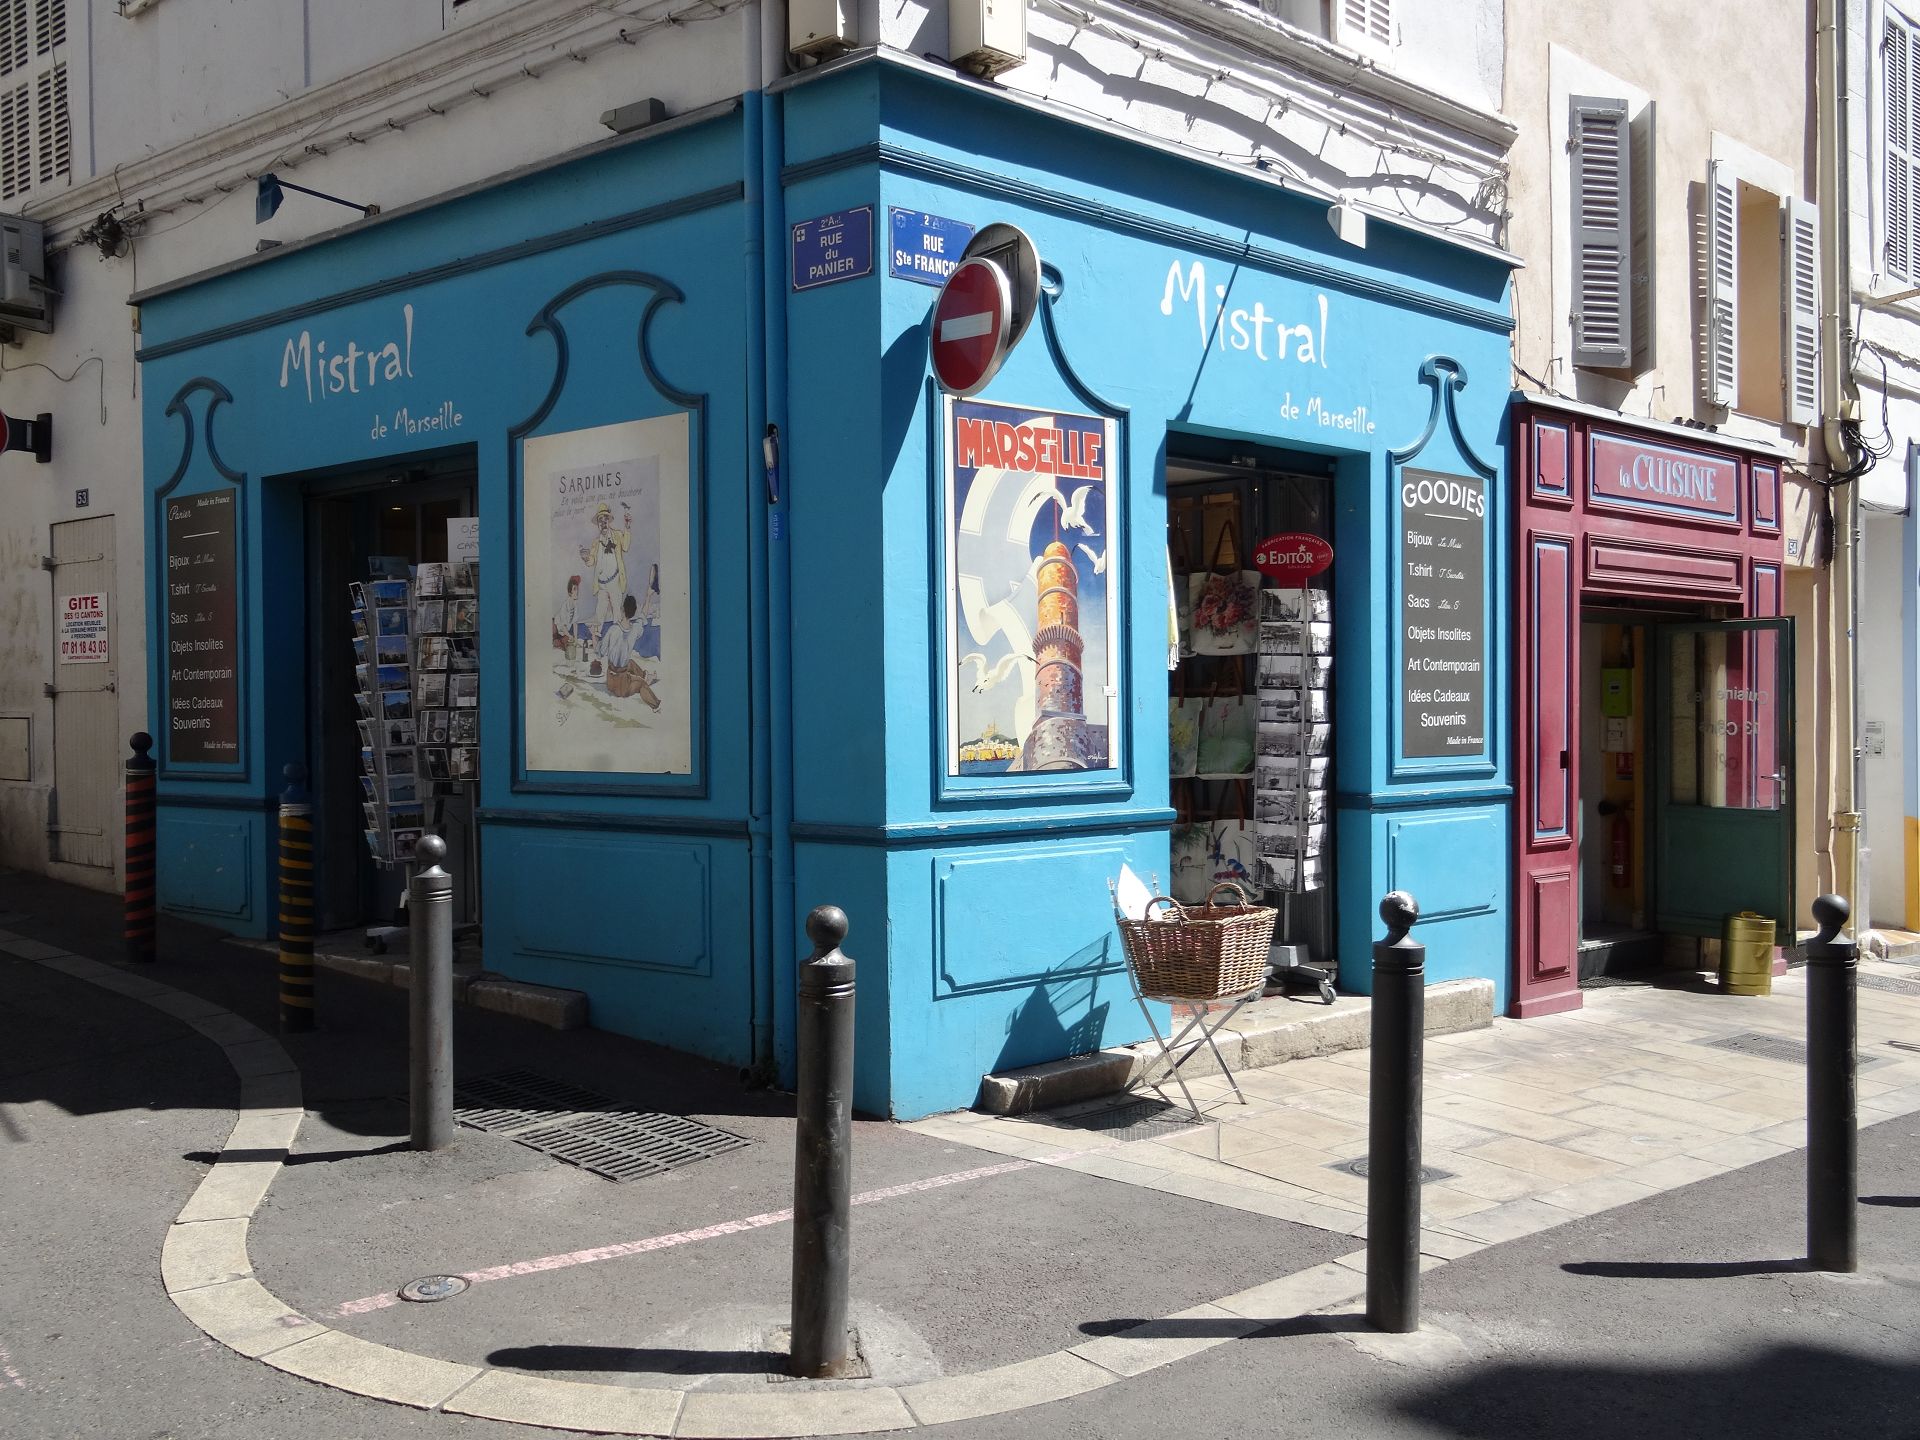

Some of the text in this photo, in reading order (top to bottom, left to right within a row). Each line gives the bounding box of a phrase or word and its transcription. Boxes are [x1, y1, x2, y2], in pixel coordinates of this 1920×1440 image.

[820, 232, 843, 248] RUE
[923, 234, 944, 254] RUE
[825, 249, 838, 260] du
[809, 257, 854, 279] PANIER
[896, 250, 959, 277] Ste FRANÇO
[1160, 259, 1329, 369] Mistral
[279, 303, 414, 404] Mistral
[371, 401, 463, 440] de Marseille
[1280, 392, 1376, 435] de Marseille
[559, 471, 622, 494] SARDINES
[1618, 453, 1717, 502] la CUISINE
[1402, 480, 1485, 518] GOODIES
[1407, 530, 1433, 548] Bijoux
[169, 555, 190, 570] Bijoux
[1269, 550, 1314, 565] EDITOR
[1407, 562, 1433, 578] T.shirt
[170, 583, 190, 596] T.shirt
[69, 596, 99, 610] GITE
[1407, 593, 1430, 609] Sacs
[64, 612, 73, 620] DES
[81, 610, 104, 619] CANTONS
[170, 612, 188, 625] Sacs
[1407, 625, 1472, 643] Objets Insolites
[62, 640, 107, 654] 07 81 18 43 03
[171, 638, 224, 655] Objets Insolites
[1407, 657, 1480, 674] Art Contemporain
[171, 668, 232, 682] Art Contemporain
[172, 696, 224, 710] Idées Cadeaux
[1408, 688, 1470, 703] Idées Cadeaux
[173, 715, 211, 730] Souvenirs
[1420, 711, 1467, 727] Souvenirs
[1446, 736, 1484, 745] Made in France
